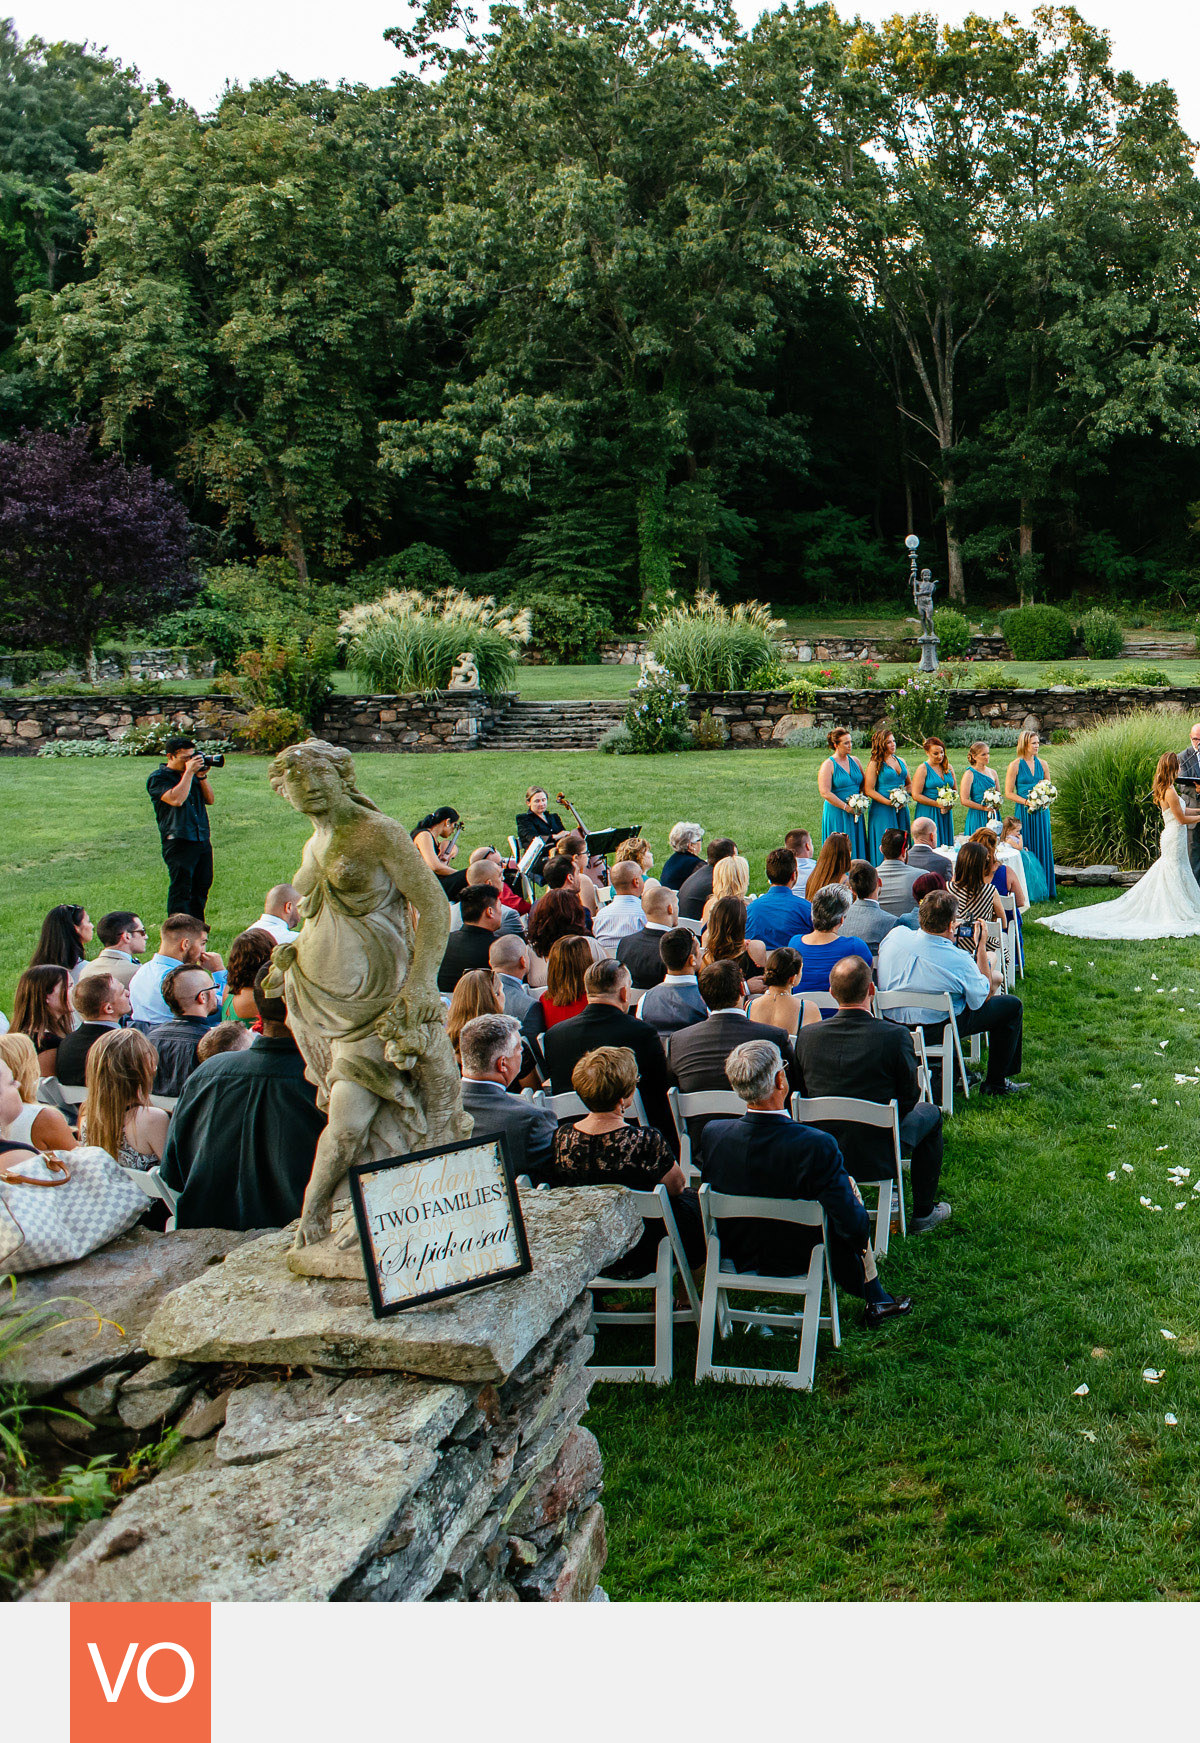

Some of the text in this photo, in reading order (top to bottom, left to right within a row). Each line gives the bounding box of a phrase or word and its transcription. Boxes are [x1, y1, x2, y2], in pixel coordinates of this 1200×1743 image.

[389, 1158, 479, 1206] Today
[375, 1183, 502, 1232] TWO FAMILIES
[387, 1204, 497, 1244] BECOME ONE
[379, 1222, 511, 1281] So pick a seat
[396, 1249, 505, 1294] NOT A SIDE
